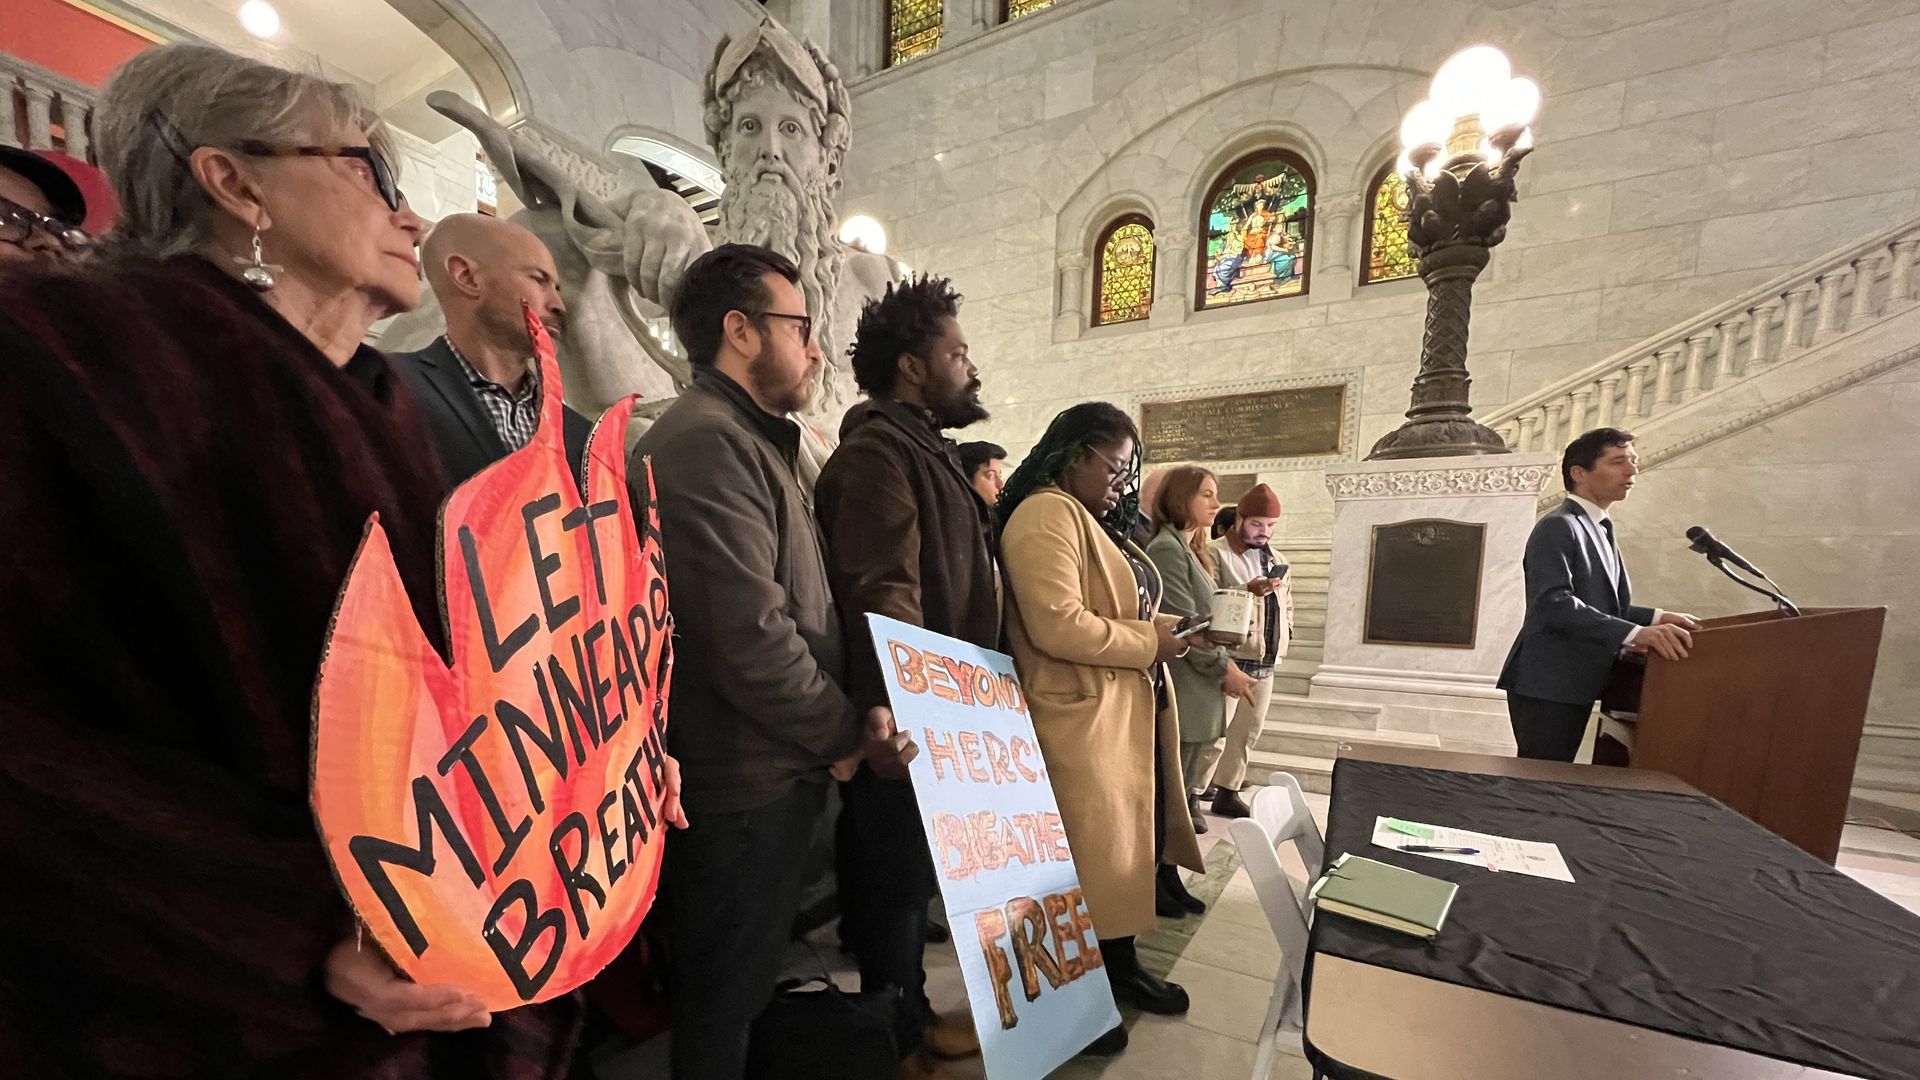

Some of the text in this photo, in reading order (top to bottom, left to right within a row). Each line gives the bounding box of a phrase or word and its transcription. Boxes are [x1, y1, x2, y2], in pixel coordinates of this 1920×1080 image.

[1202, 407, 1221, 415] HALL
[1293, 392, 1311, 400] AND
[458, 493, 618, 672] LET
[888, 638, 1028, 714] BEYOND
[482, 700, 668, 1001] BREATHE
[932, 809, 1070, 881] BREATHE
[974, 888, 1104, 1030] FREE
